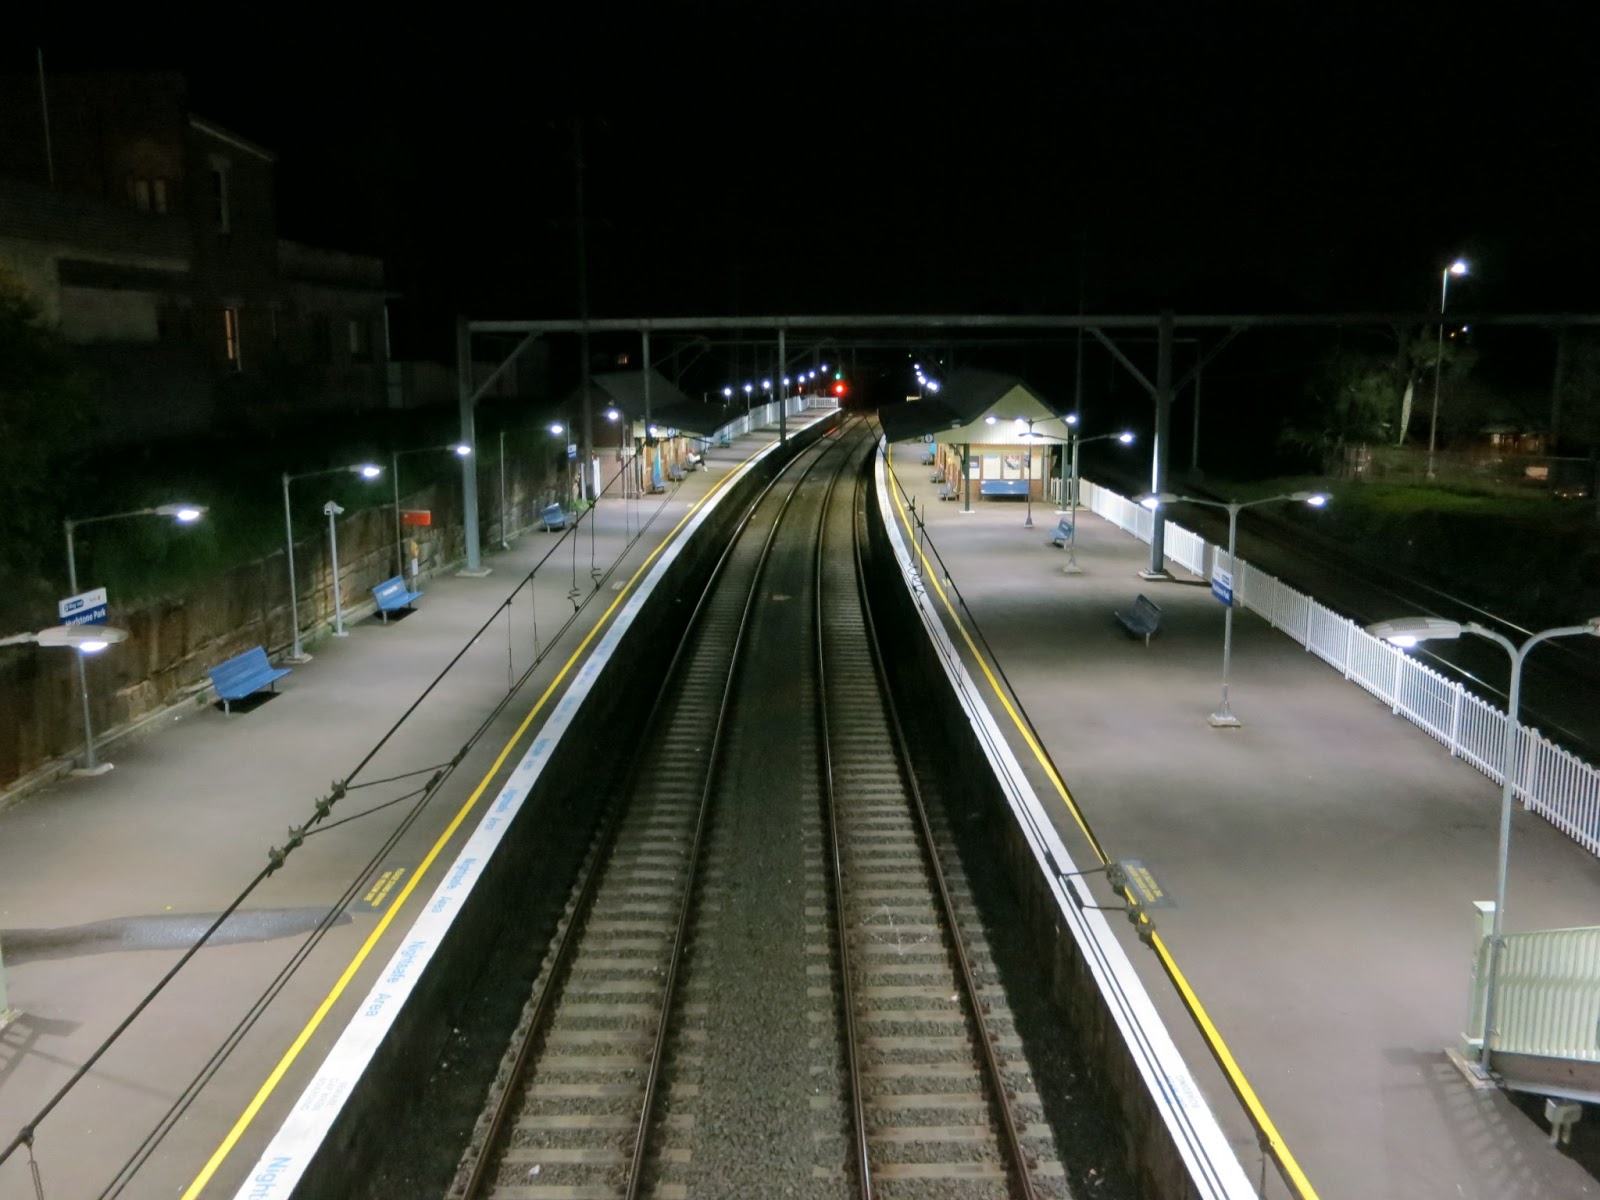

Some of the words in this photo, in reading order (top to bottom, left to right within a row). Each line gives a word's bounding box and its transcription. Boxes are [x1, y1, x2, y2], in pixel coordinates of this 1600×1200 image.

[93, 608, 106, 620] Park
[387, 941, 426, 983] Nightsafe
[365, 993, 392, 1017] Area
